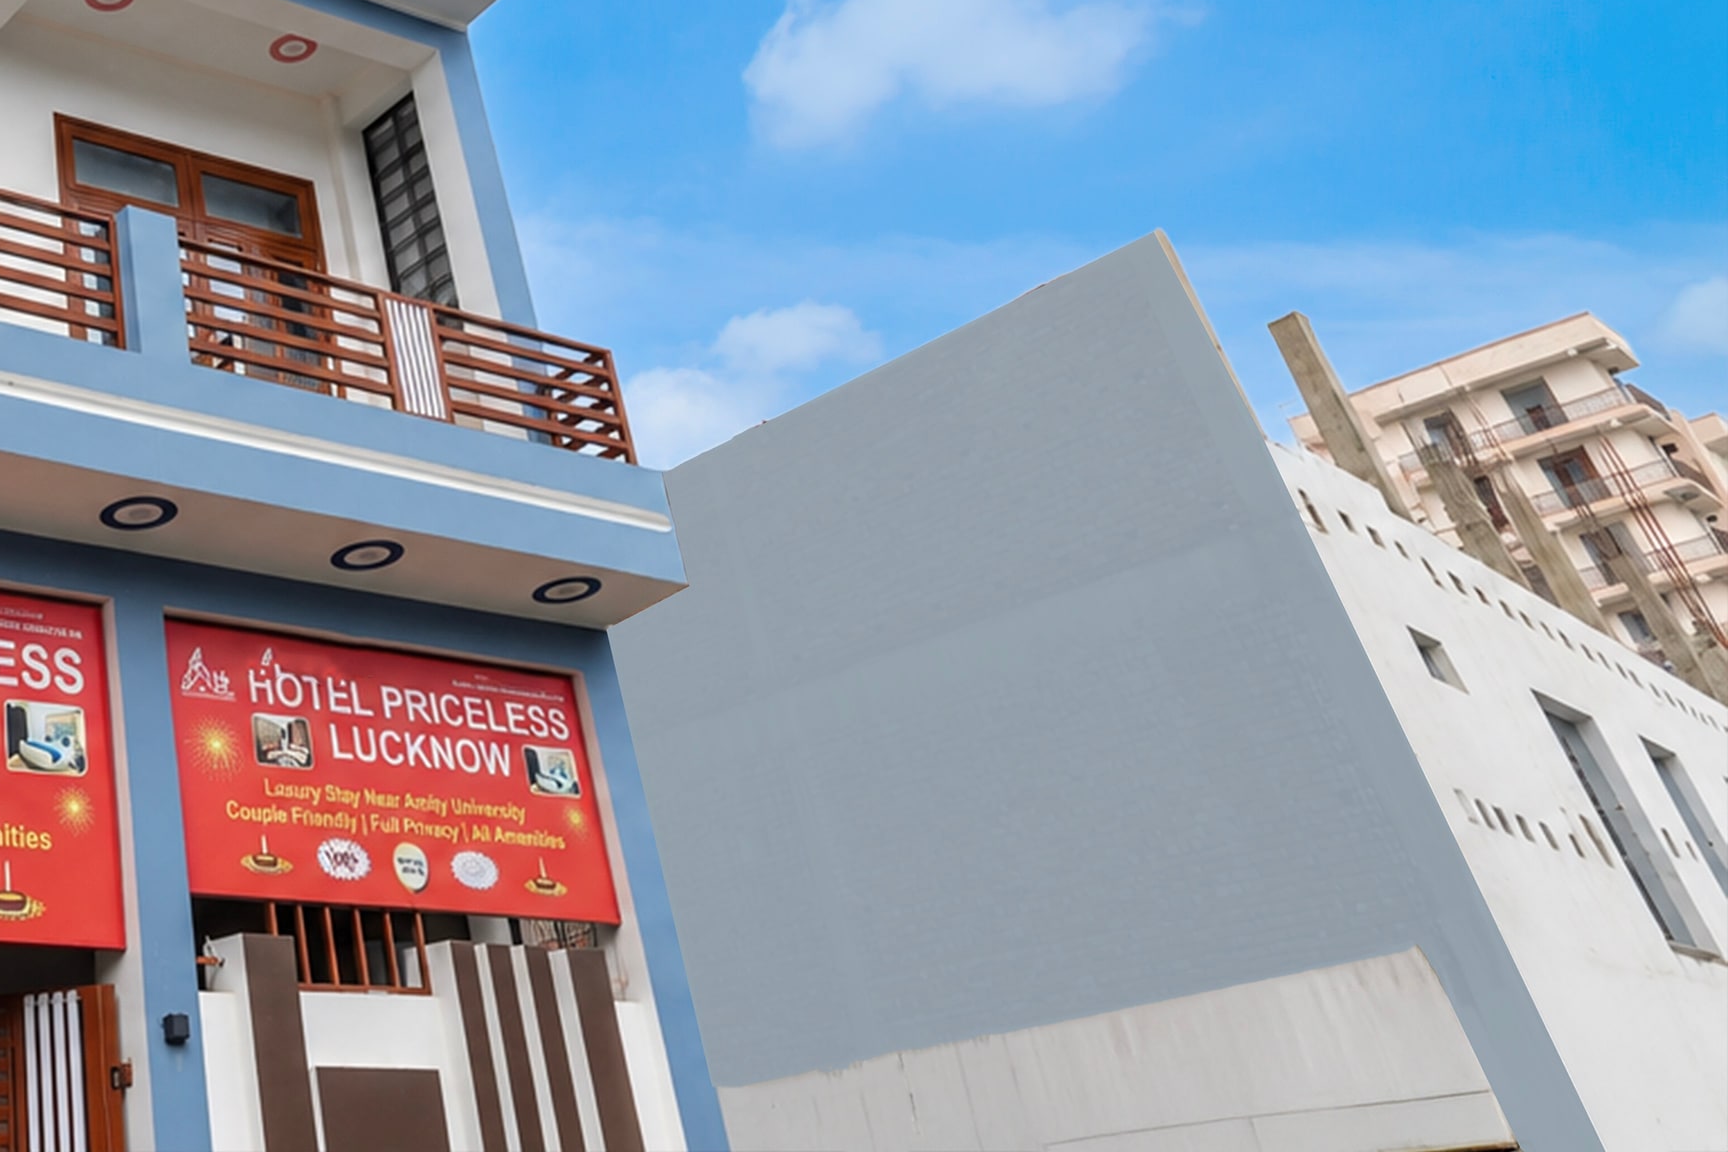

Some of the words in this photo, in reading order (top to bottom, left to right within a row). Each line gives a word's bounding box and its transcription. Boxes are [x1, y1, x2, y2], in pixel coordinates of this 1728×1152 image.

[248, 665, 374, 716] HOTEL
[380, 685, 570, 740] PRICELESS
[329, 723, 510, 777] LUCKNOW
[370, 814, 400, 833] Full
